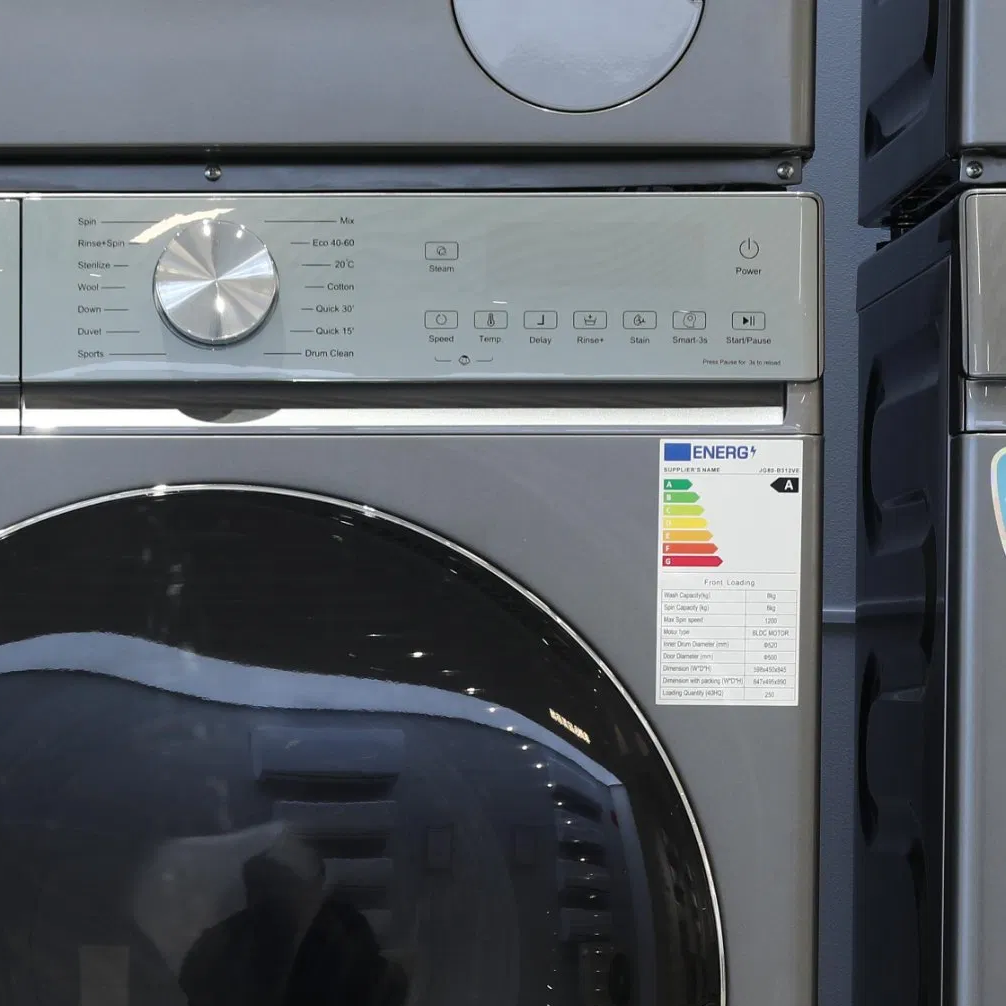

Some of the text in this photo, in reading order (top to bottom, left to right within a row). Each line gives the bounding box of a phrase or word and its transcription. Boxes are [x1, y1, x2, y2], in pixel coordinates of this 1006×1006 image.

[78, 218, 96, 226] Spin
[78, 240, 124, 248] Rinse+Spin
[736, 267, 762, 275] Power
[316, 305, 339, 313] Quick
[428, 336, 454, 344] Speed
[480, 336, 504, 344] Temp.
[530, 336, 552, 344] Delay
[78, 350, 104, 358] Sports
[694, 446, 748, 459] ENERG
[784, 480, 794, 490] A
